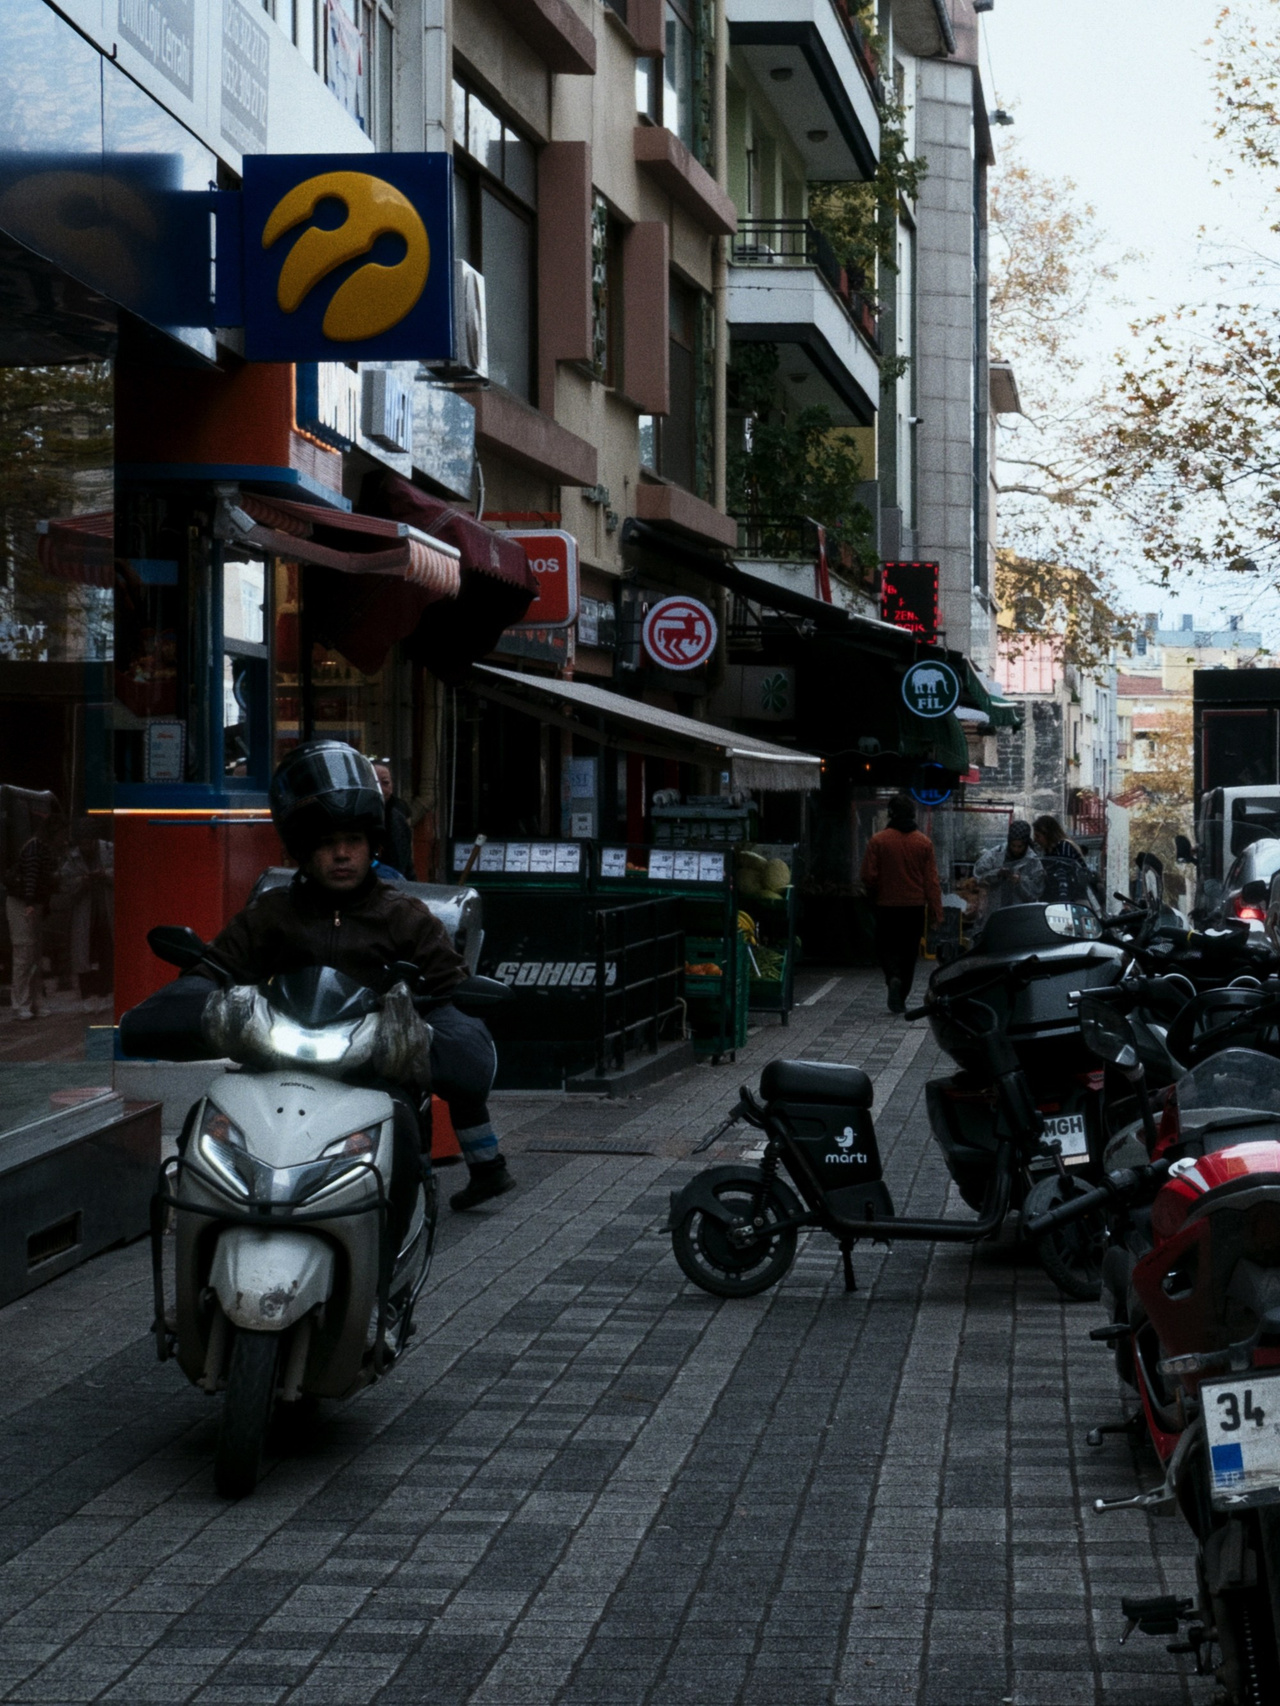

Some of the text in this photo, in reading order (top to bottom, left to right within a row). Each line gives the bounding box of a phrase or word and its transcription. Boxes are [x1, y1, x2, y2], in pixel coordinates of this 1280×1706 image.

[162, 16, 190, 87] Cerrahi
[917, 694, 944, 710] FİL
[1044, 1116, 1083, 1138] MGH
[1217, 1389, 1265, 1431] 34
[1221, 1471, 1242, 1485] TR
